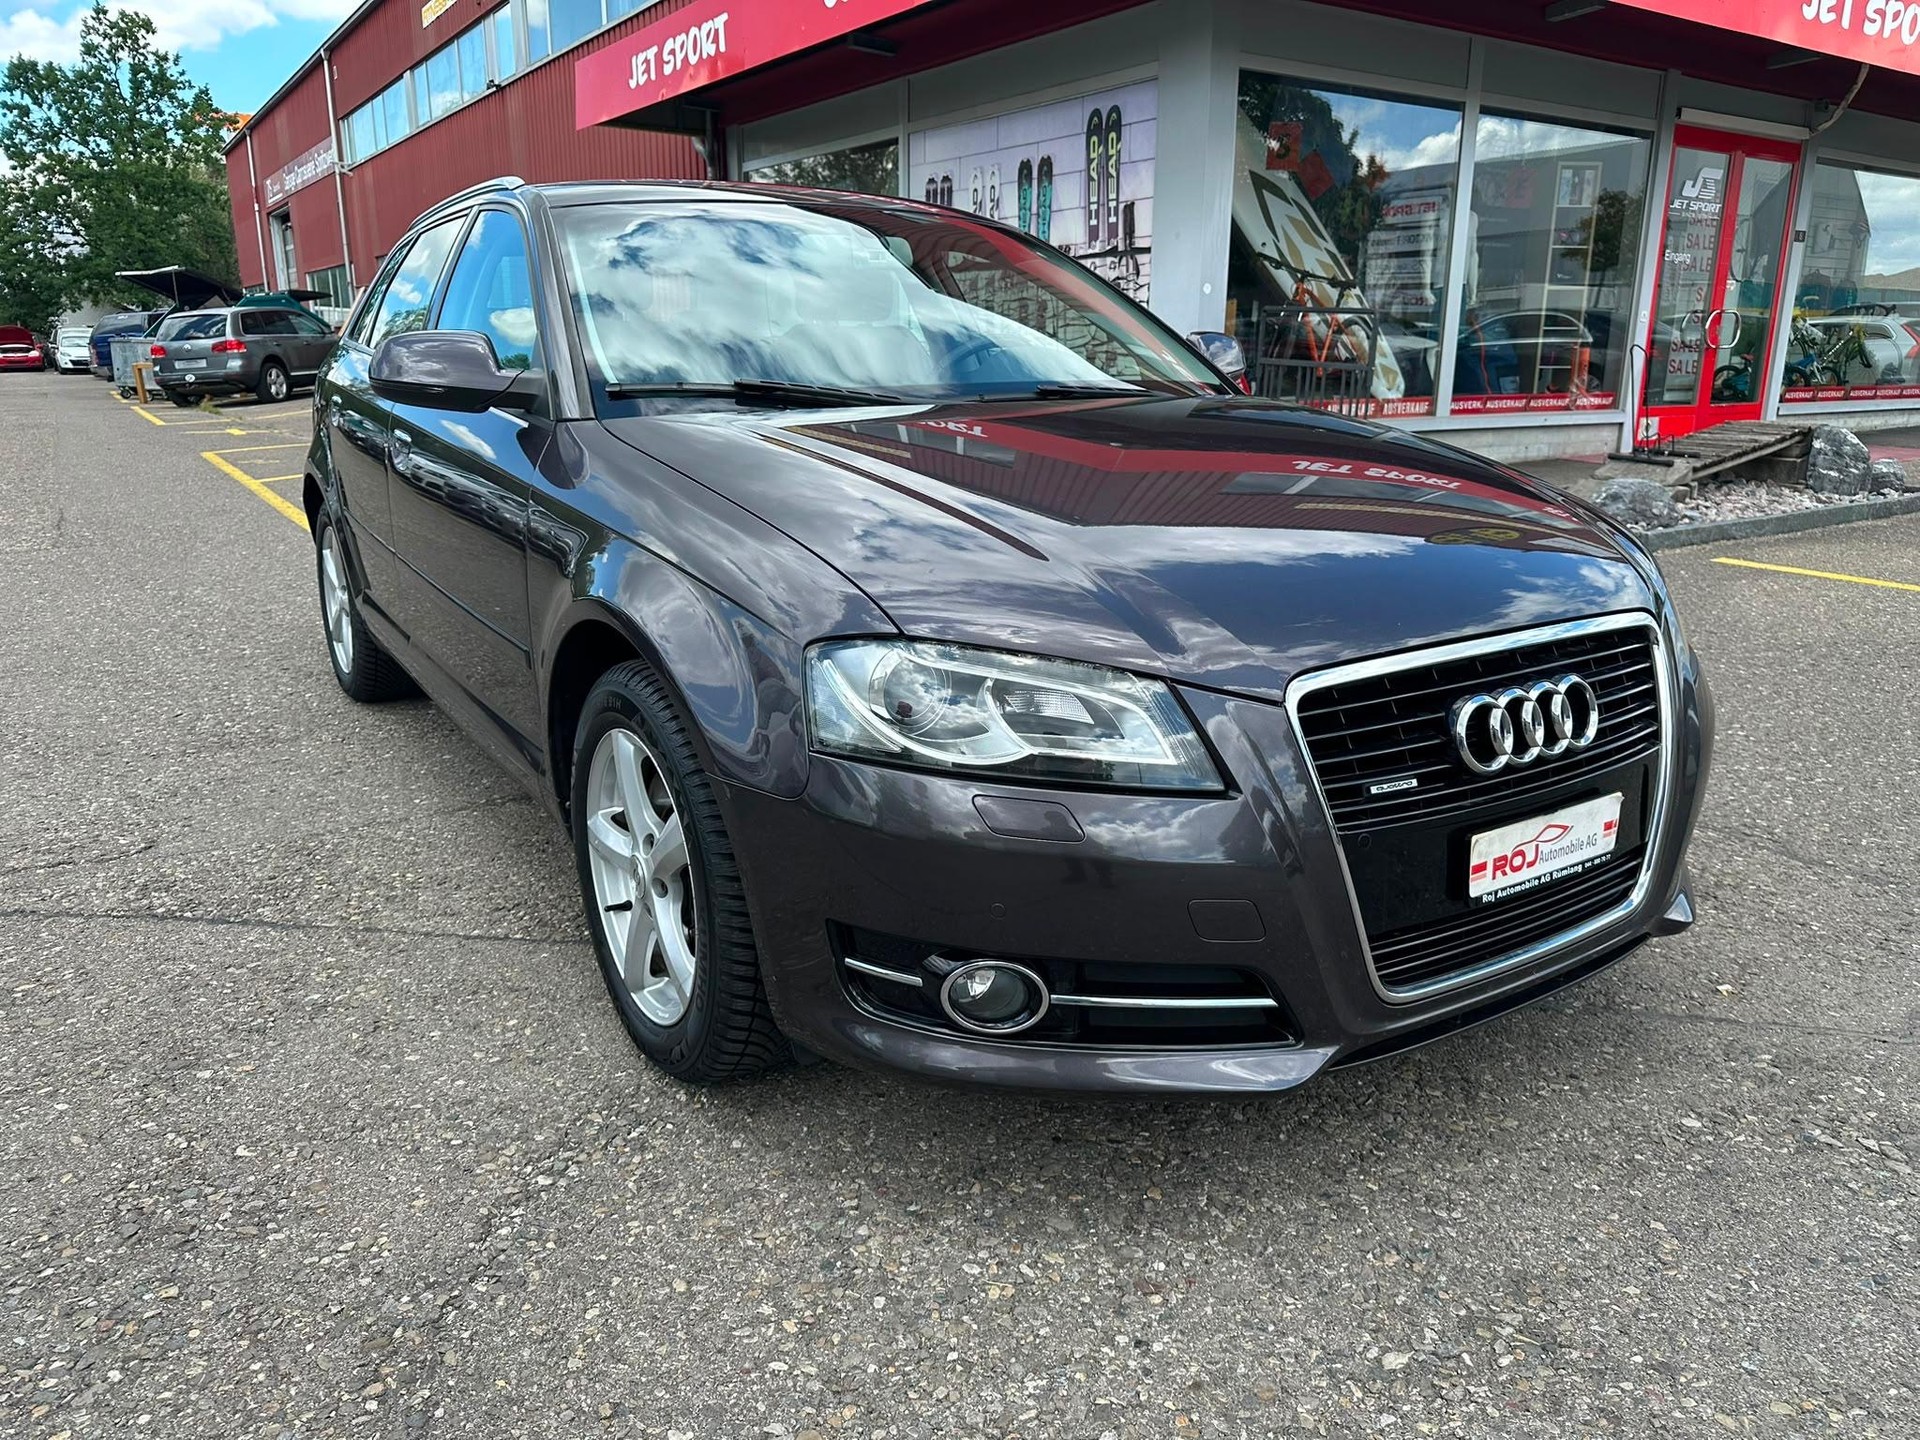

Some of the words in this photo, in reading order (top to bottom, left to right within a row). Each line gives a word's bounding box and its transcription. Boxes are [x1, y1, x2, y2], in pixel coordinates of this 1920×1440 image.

[628, 45, 659, 89] JET
[662, 12, 728, 76] SPORT
[1089, 134, 1099, 226] HEAD
[1108, 131, 1118, 223] HEAD
[1669, 199, 1689, 209] JET
[1689, 201, 1722, 213] SPORT
[1686, 233, 1714, 250] SALE
[1664, 249, 1691, 264] Eingang
[1668, 359, 1698, 375] SALE
[1382, 402, 1430, 415] AUSVERKAUF
[1485, 400, 1526, 409] AUSVERKAUF
[1529, 399, 1569, 407] AUSVERKAUF
[1492, 843, 1539, 881] ROJ
[1539, 837, 1585, 865] Automobile
[1586, 832, 1598, 849] AG
[1483, 889, 1496, 903] Roj
[1497, 878, 1540, 899] Automobile
[1540, 874, 1551, 885] AG
